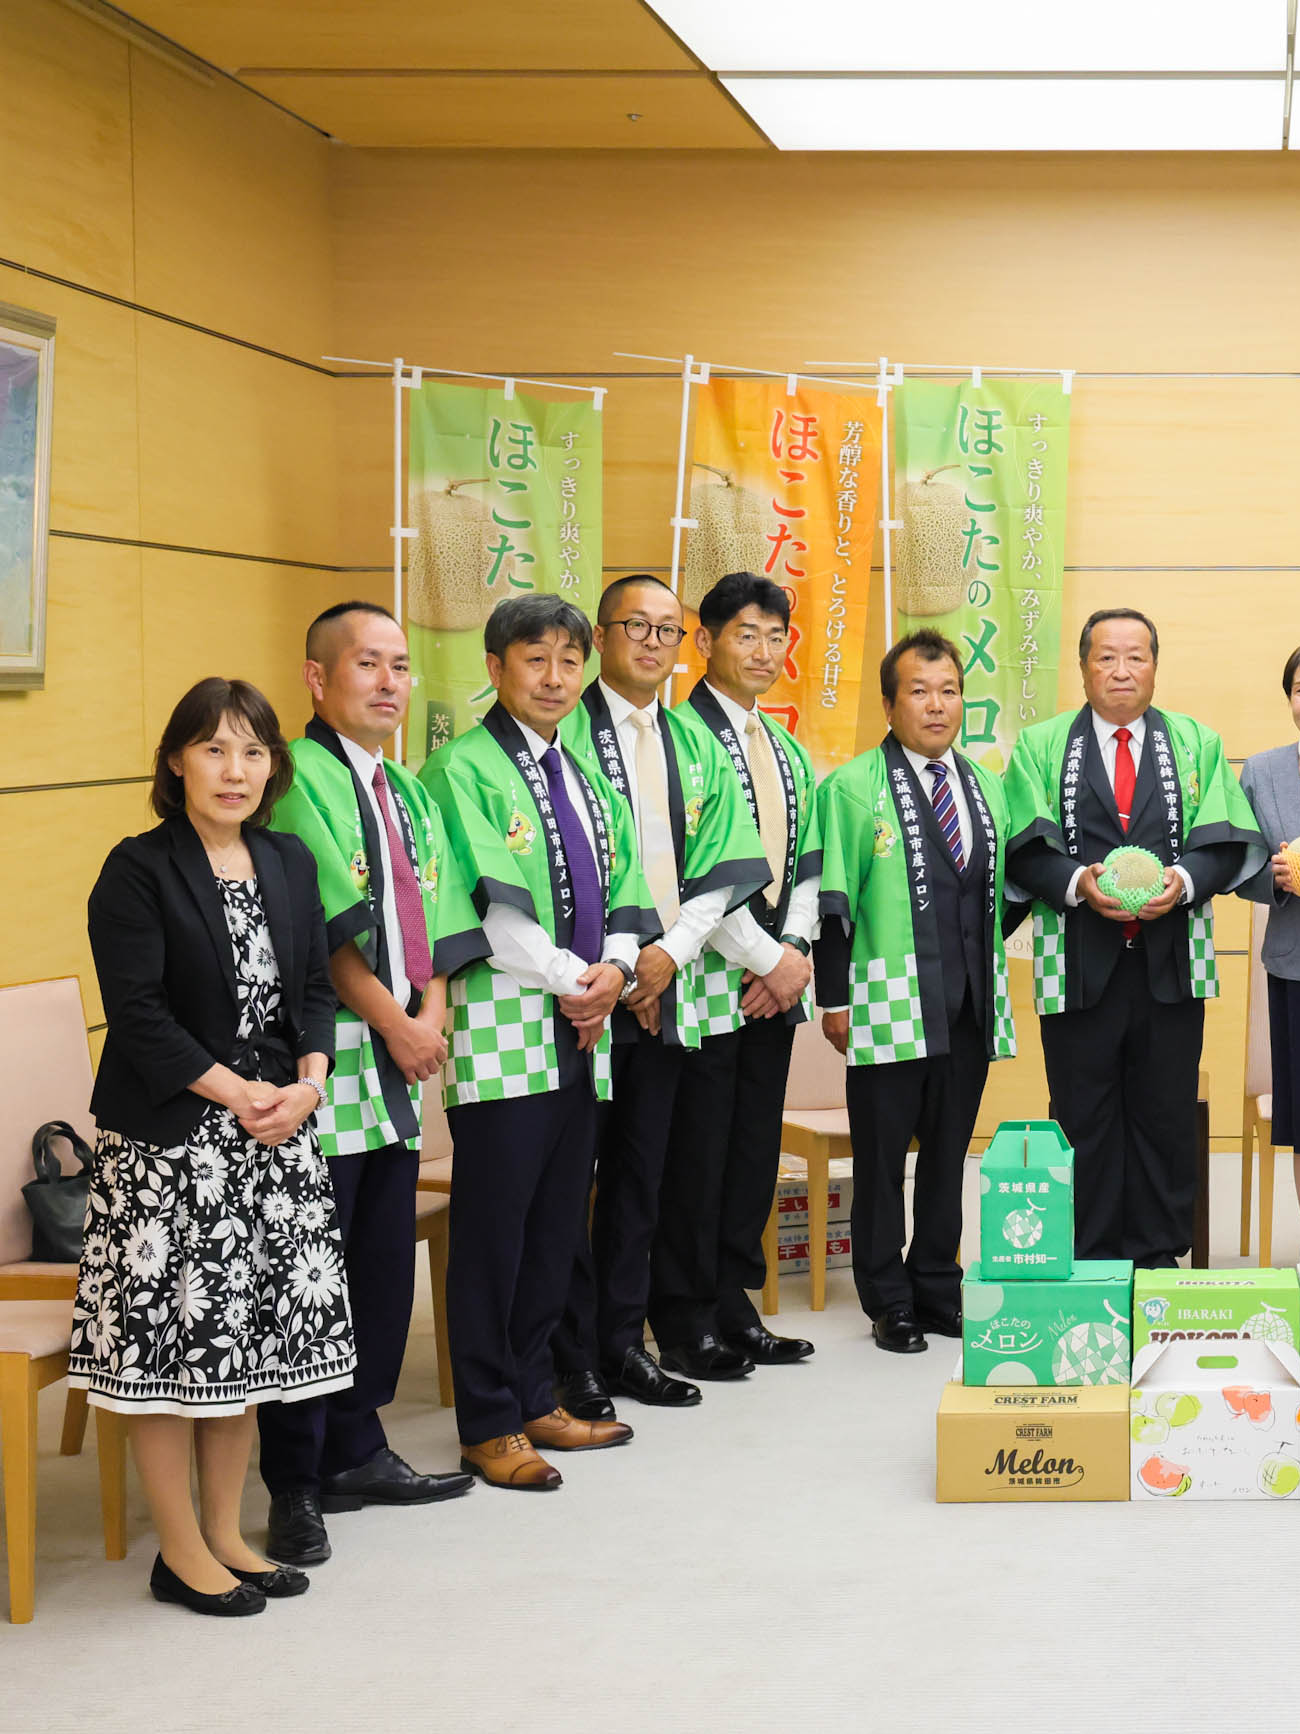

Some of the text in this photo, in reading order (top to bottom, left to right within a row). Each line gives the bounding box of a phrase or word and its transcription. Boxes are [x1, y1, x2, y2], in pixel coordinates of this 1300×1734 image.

[820, 421, 864, 708] 芳醇な香りと、とろける甘さ
[1020, 413, 1048, 720] すっきり爽やか、みずみずしい
[1152, 730, 1181, 864] 茨城県鉾田市産メロン
[516, 751, 575, 919] 茨城県鉾田市産メロン
[892, 768, 930, 912] 茨城県鉾田市産メロン
[998, 1182, 1050, 1194] 茨城県産
[1013, 1254, 1058, 1264] 市村知一
[1177, 1309, 1233, 1320] IBARAKI
[990, 1317, 1031, 1330] ほこたの
[973, 1329, 1041, 1350] メロン
[994, 1395, 1078, 1405] CREST FARM
[1016, 1428, 1053, 1438] CREST FARM
[985, 1449, 1083, 1475] Melon
[1008, 1477, 1061, 1486] 茨城県鉾田市
